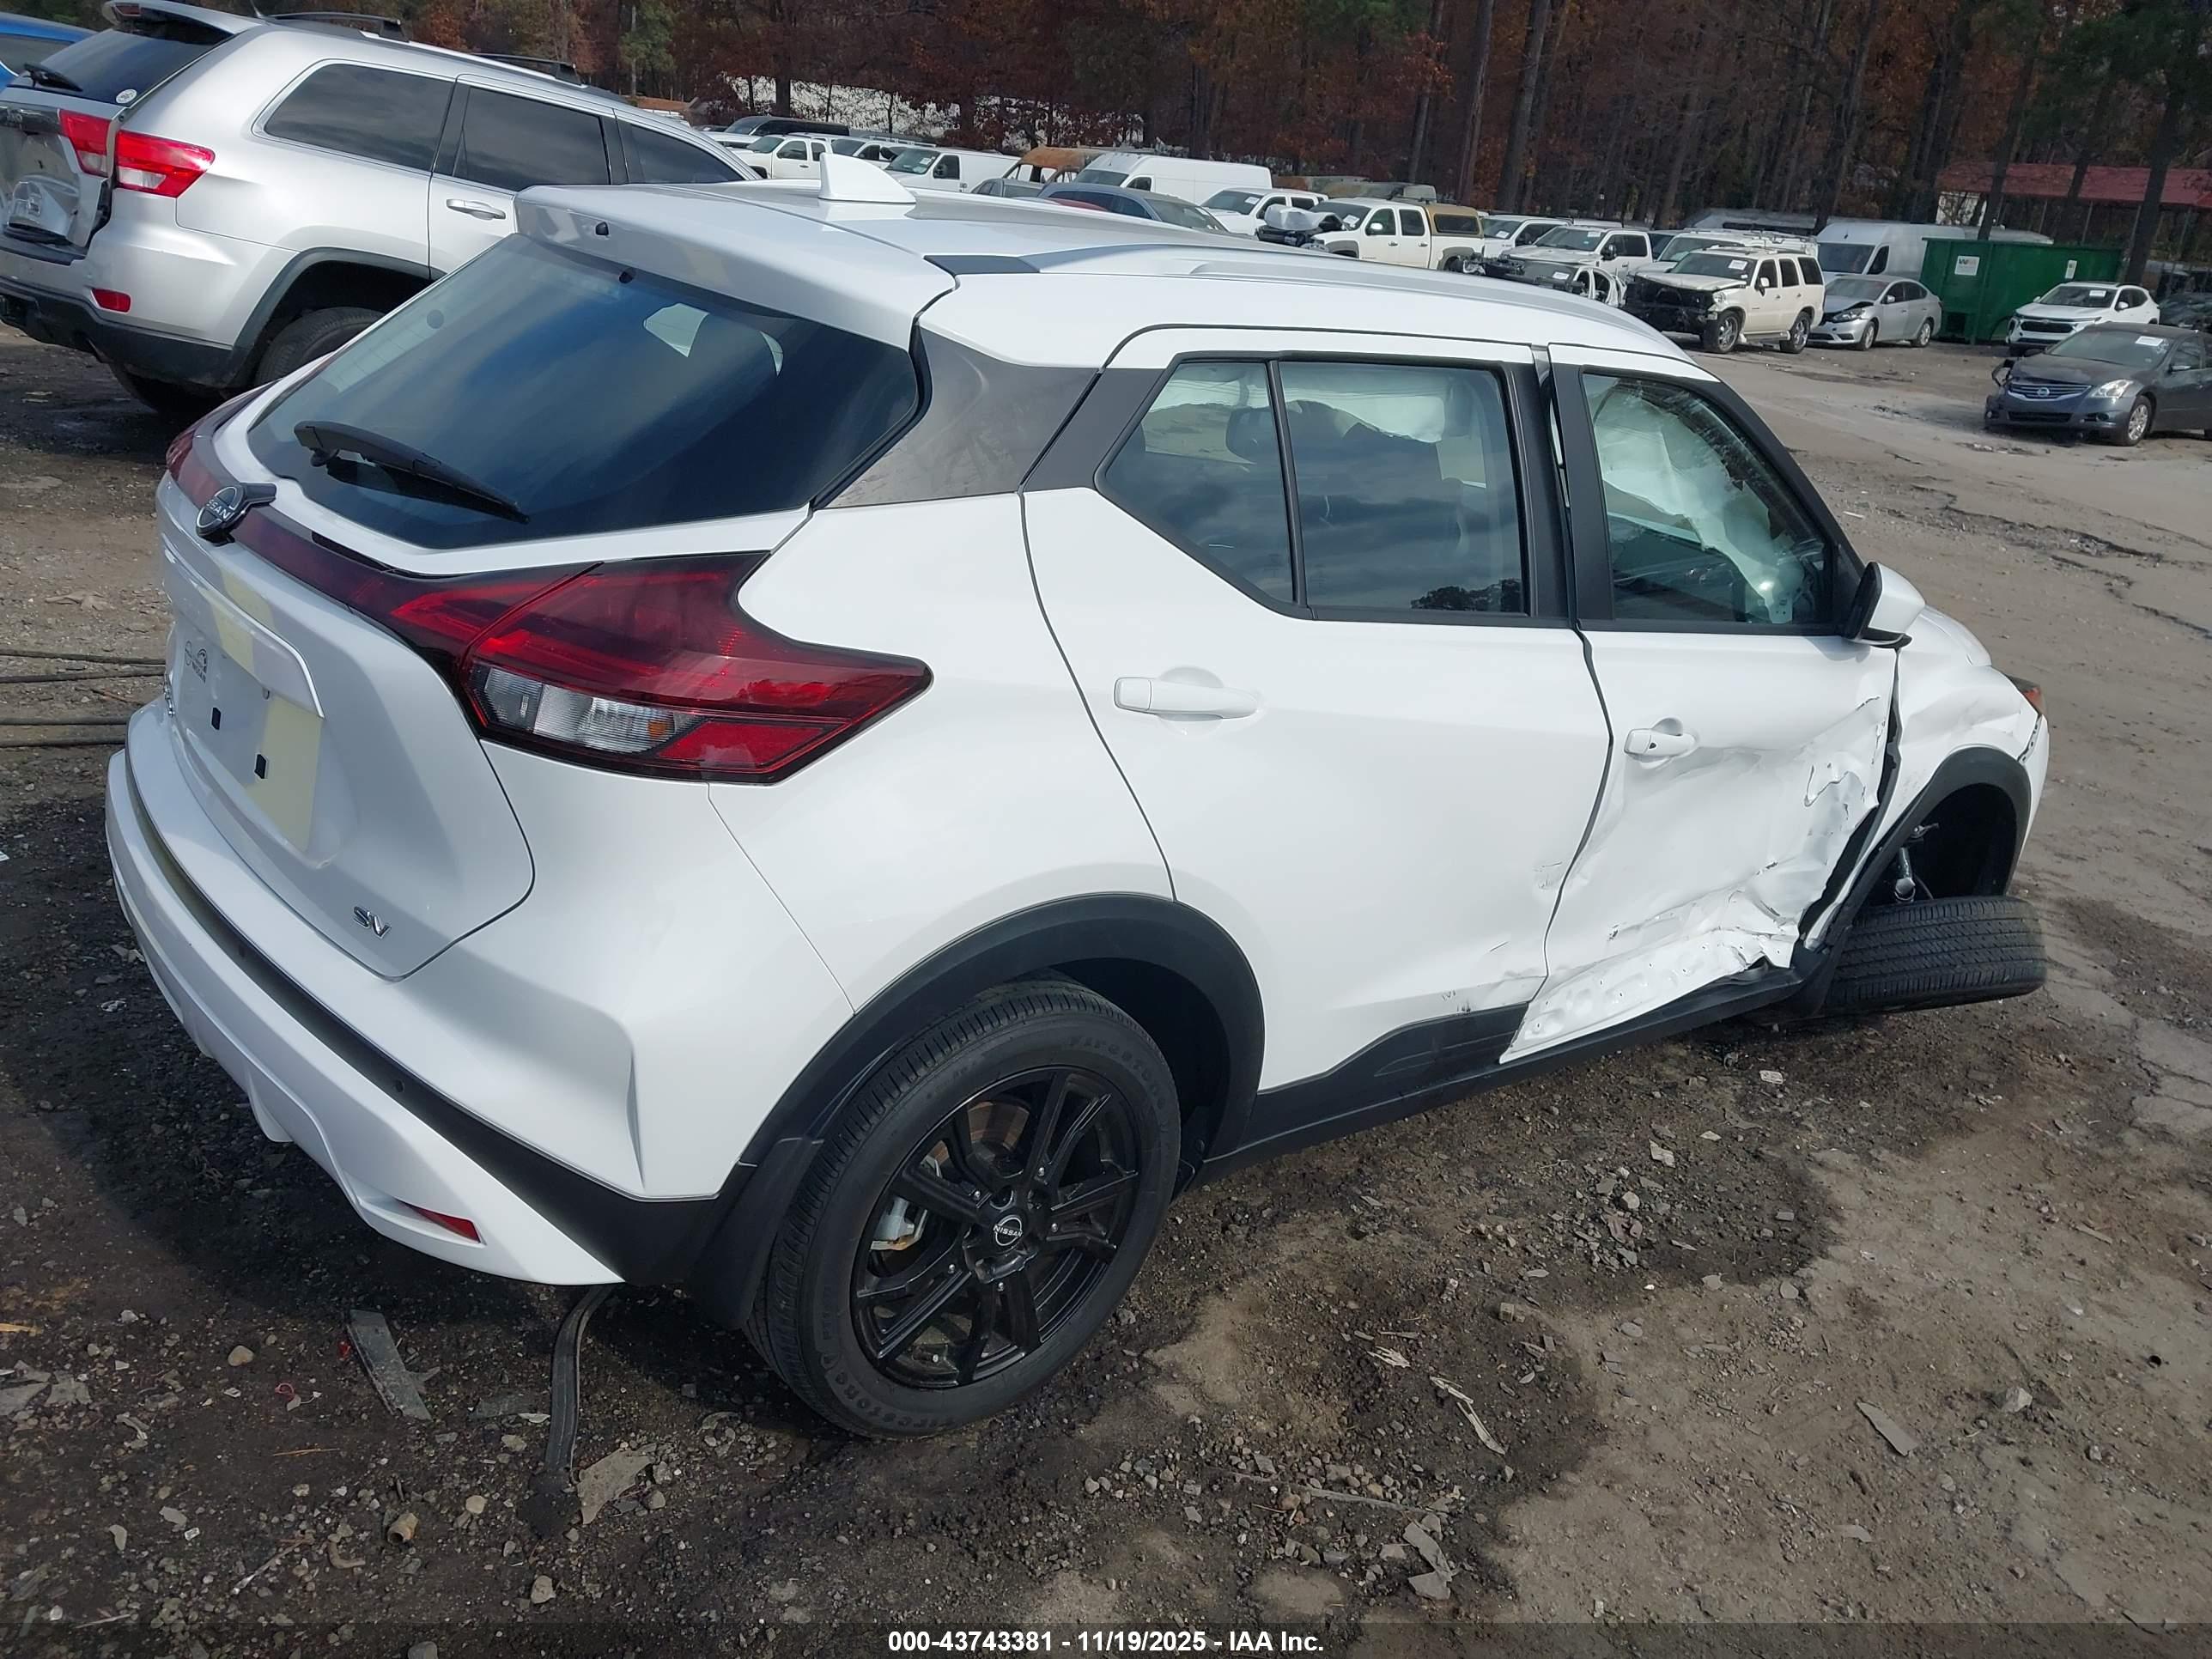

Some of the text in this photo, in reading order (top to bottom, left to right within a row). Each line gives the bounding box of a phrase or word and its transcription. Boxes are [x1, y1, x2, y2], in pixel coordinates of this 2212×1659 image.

[205, 498, 231, 520] SSAN
[353, 906, 392, 938] SV
[993, 1224, 1023, 1237] NISSAN
